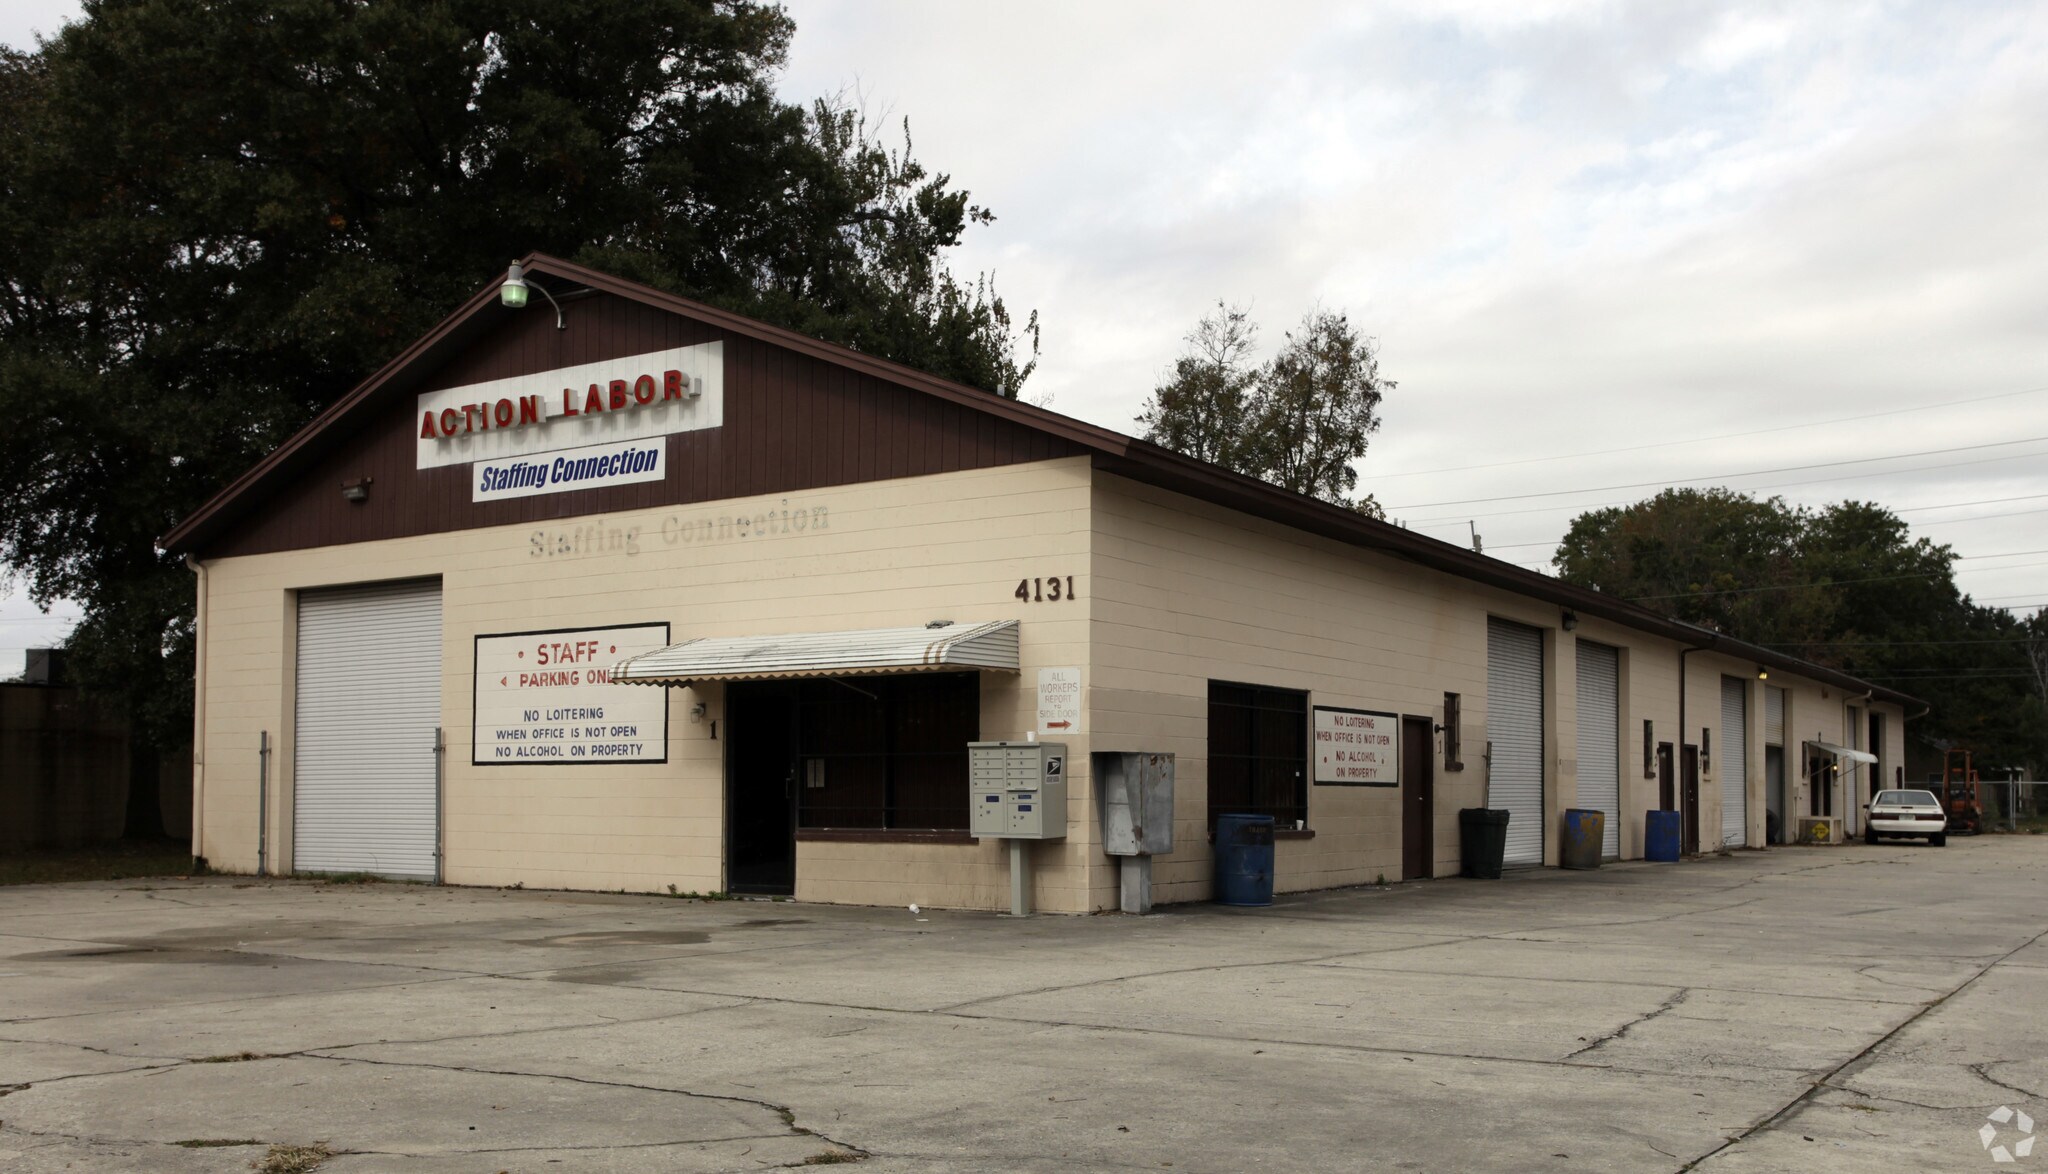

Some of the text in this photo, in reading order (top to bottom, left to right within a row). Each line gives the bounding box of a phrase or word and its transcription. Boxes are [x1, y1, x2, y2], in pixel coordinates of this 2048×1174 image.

[420, 369, 687, 439] ACTION LABOR
[480, 447, 659, 493] Staffing Connection
[530, 498, 829, 558] Staffing Connection
[1014, 575, 1075, 603] 4131
[537, 640, 599, 665] STAFF
[519, 669, 613, 688] PARKING ONL
[1051, 672, 1066, 682] ALL
[1040, 682, 1078, 693] WORKERS
[1044, 695, 1072, 703] REPORT
[523, 707, 604, 722] NO LOITERING
[1039, 710, 1078, 718] SIDE DOOR
[1334, 715, 1375, 729] NO LOITERING
[496, 726, 637, 740] WHEN OFFICE IS NOT OPEN
[709, 720, 718, 740] 1
[1316, 731, 1390, 746] WHEN OFFICE IS NOT OPEN
[495, 743, 643, 757] NO ALCOHOL ON PROPERTY
[1336, 751, 1376, 763] NO ALCOHOL
[1336, 767, 1378, 779] ON PROPERTY
